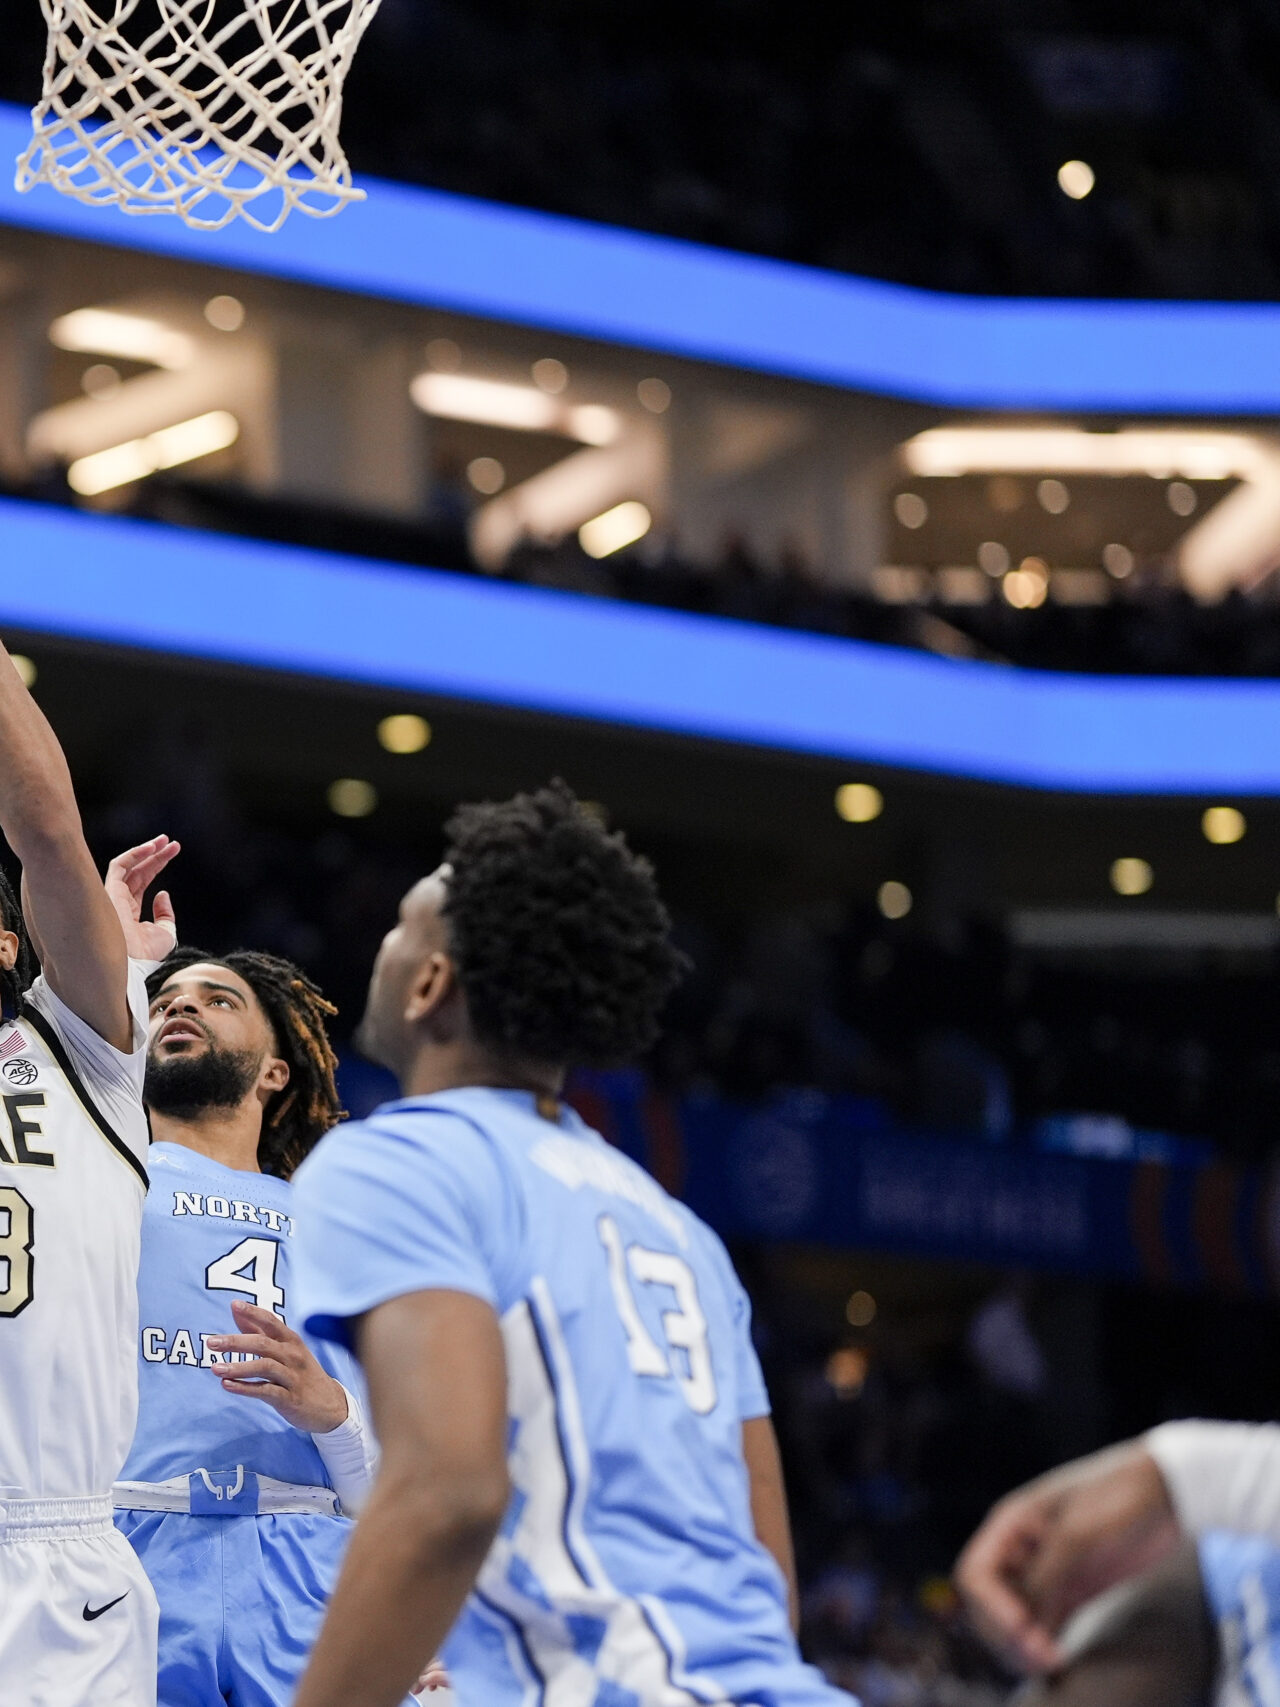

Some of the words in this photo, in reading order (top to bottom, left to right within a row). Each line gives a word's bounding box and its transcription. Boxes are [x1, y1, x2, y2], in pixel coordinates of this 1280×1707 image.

[9, 1063, 34, 1076] ACC
[205, 1236, 286, 1326] 4
[595, 1212, 717, 1417] 13
